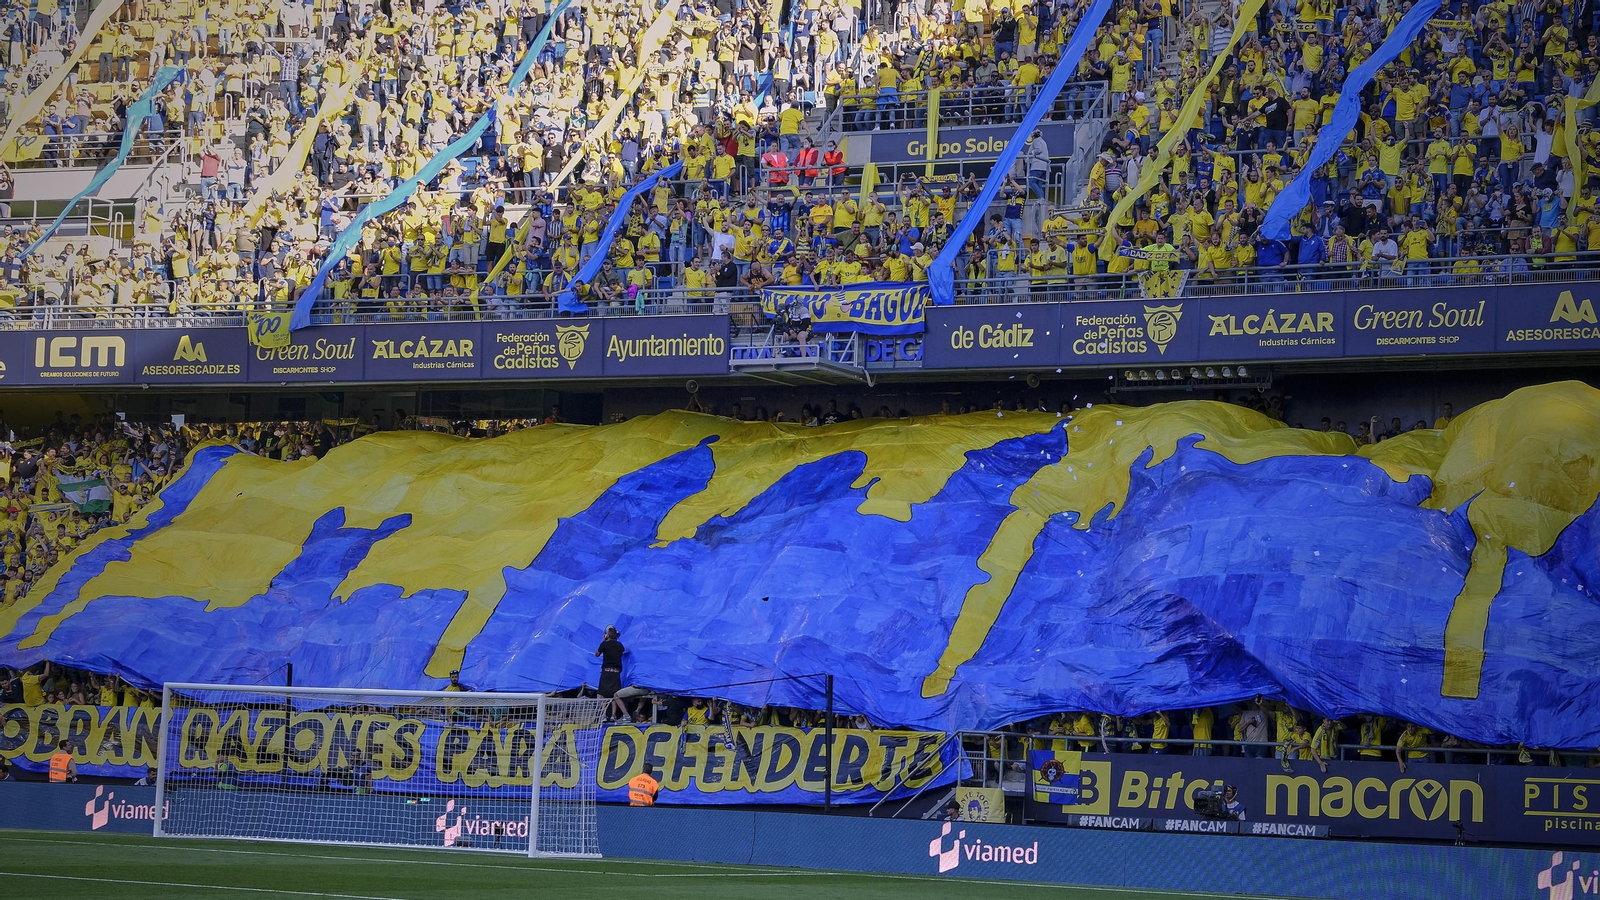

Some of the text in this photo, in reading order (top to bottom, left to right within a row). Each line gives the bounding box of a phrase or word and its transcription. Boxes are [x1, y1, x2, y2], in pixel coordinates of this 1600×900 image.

[907, 140, 961, 158] Grpo
[1076, 313, 1137, 326] Federación
[1207, 308, 1335, 336] ALCÁZAR
[1353, 300, 1486, 330] Green Soul
[496, 332, 550, 343] Federación
[951, 324, 1034, 349] de Cádiz
[1083, 324, 1144, 340] de Peñas
[1376, 335, 1460, 346] DISCARMONTES SHOP
[256, 343, 309, 361] Green
[312, 337, 356, 361] Soul
[371, 335, 474, 359] ALCÁZAR
[503, 342, 556, 356] de Peñas
[606, 333, 725, 363] Ayuntamiento
[867, 339, 895, 362] DE
[1072, 337, 1148, 356] Cadistas
[1259, 336, 1336, 347] Industrias Cárnicas
[35, 336, 126, 368] ICM
[142, 364, 241, 376] ASESORESCADIZ.ES
[273, 366, 337, 374] DISCARMONTES SHOP
[412, 361, 475, 369] Industrias Cárnicas
[493, 354, 559, 370] Cadistas
[600, 728, 944, 788] DEFENDERTE
[1265, 774, 1484, 823] macron
[1524, 783, 1589, 811] PIS
[1079, 815, 1140, 830] #FANCAM
[1165, 819, 1227, 833] #FANCAM
[1252, 822, 1316, 837] #FANCAM
[963, 838, 1039, 865] viamed
